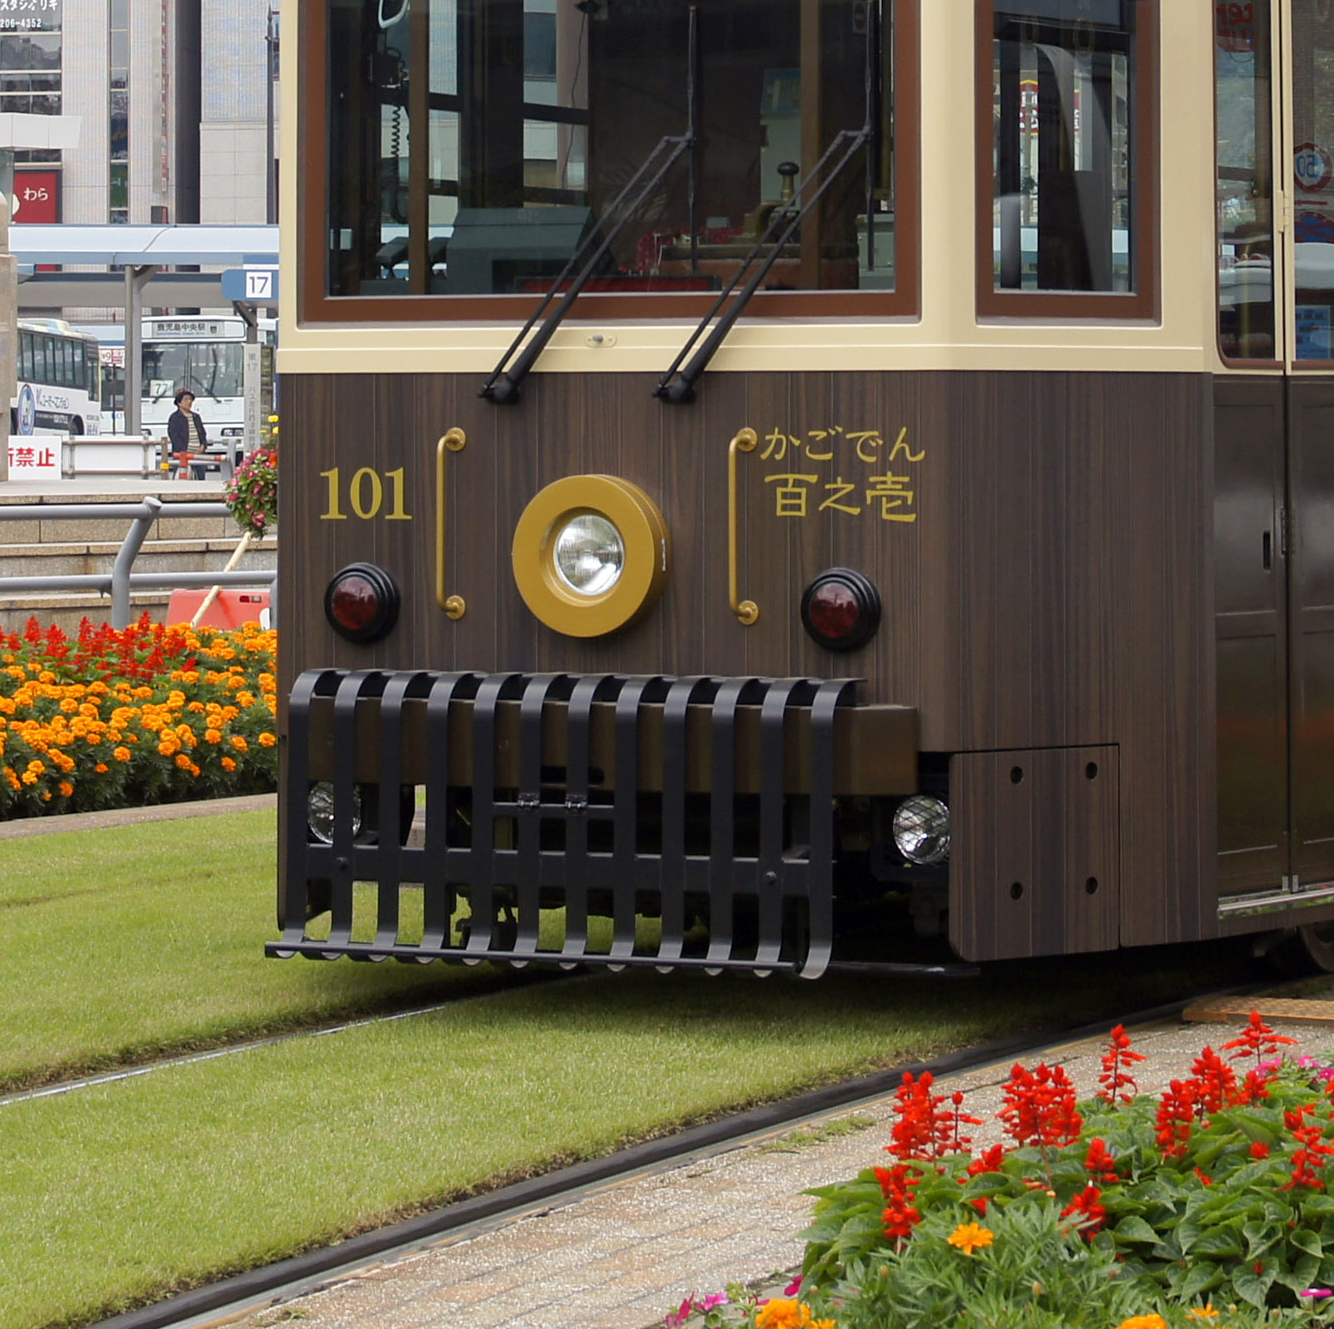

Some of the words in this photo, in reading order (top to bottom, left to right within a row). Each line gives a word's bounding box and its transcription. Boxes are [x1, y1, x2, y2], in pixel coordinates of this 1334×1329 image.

[23, 186, 49, 201] わら
[249, 276, 269, 294] 17
[760, 425, 926, 464] かごでん
[319, 467, 413, 520] 101
[764, 470, 918, 523] 百之壱
